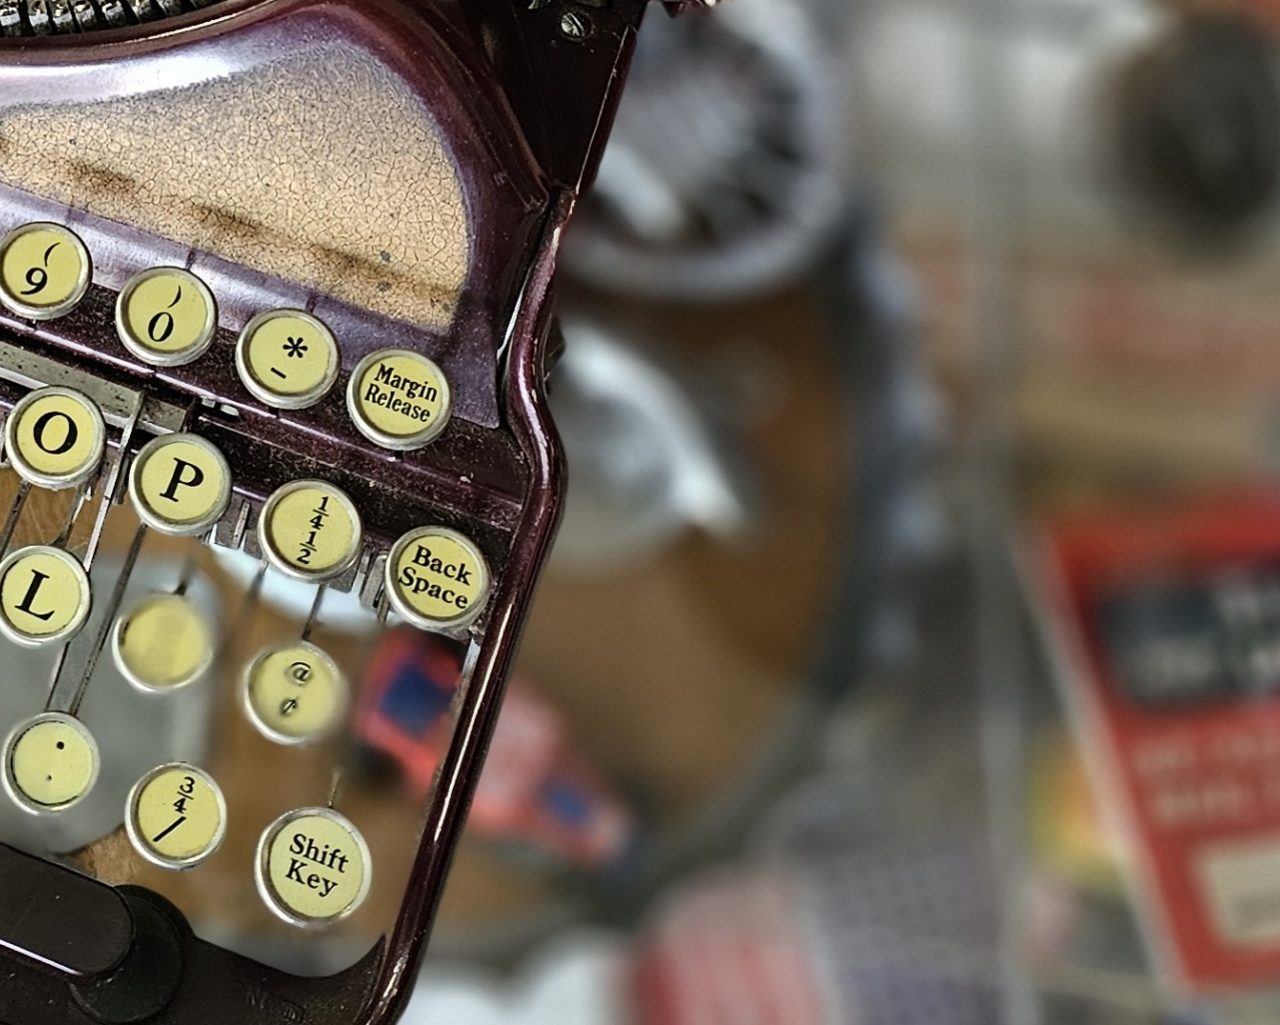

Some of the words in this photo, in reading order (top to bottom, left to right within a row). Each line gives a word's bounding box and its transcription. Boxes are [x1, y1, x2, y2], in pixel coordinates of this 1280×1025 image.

[20, 267, 48, 296] 9
[147, 311, 174, 343] 0
[364, 382, 431, 423] Release
[373, 363, 438, 403] Margin
[33, 411, 78, 455] O
[159, 457, 204, 503] P
[411, 544, 472, 586] Back
[14, 568, 55, 621] L
[399, 566, 468, 610] Space
[289, 833, 349, 874] Shift
[285, 857, 339, 898] Key
